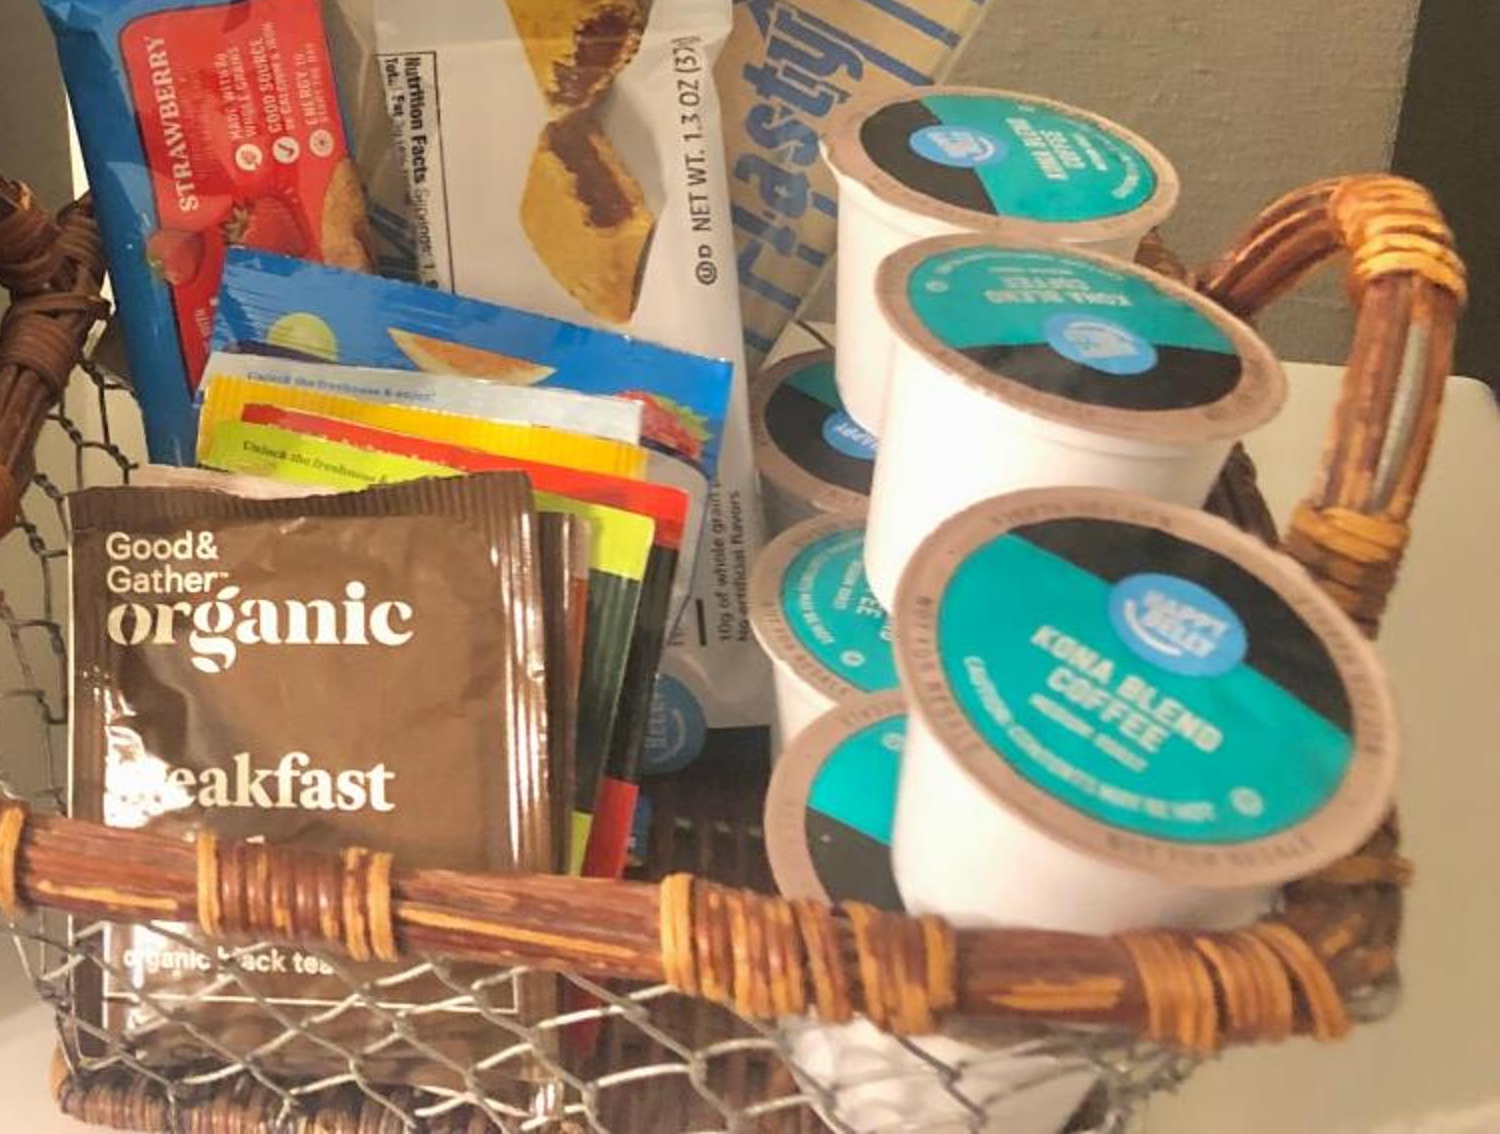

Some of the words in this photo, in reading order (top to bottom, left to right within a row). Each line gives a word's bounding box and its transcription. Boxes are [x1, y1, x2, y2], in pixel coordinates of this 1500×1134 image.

[250, 36, 275, 93] SOURCE
[261, 93, 283, 134] GOOD
[404, 56, 428, 130] Nutrition
[676, 79, 700, 107] OZ
[144, 35, 199, 212] STRAWBERRY
[681, 113, 704, 142] 1.3
[410, 134, 431, 184] Facts
[682, 148, 708, 187] WT.
[686, 192, 713, 233] NET
[728, 491, 745, 545] flavors
[711, 538, 728, 586] whole
[730, 549, 748, 616] artificial
[715, 592, 731, 608] of
[106, 580, 414, 674] organic
[1030, 623, 1117, 684] KONA
[1114, 676, 1224, 754] BLEND
[1046, 668, 1173, 752] COFFEE
[140, 749, 396, 812] eakfast
[123, 947, 211, 974] oganic
